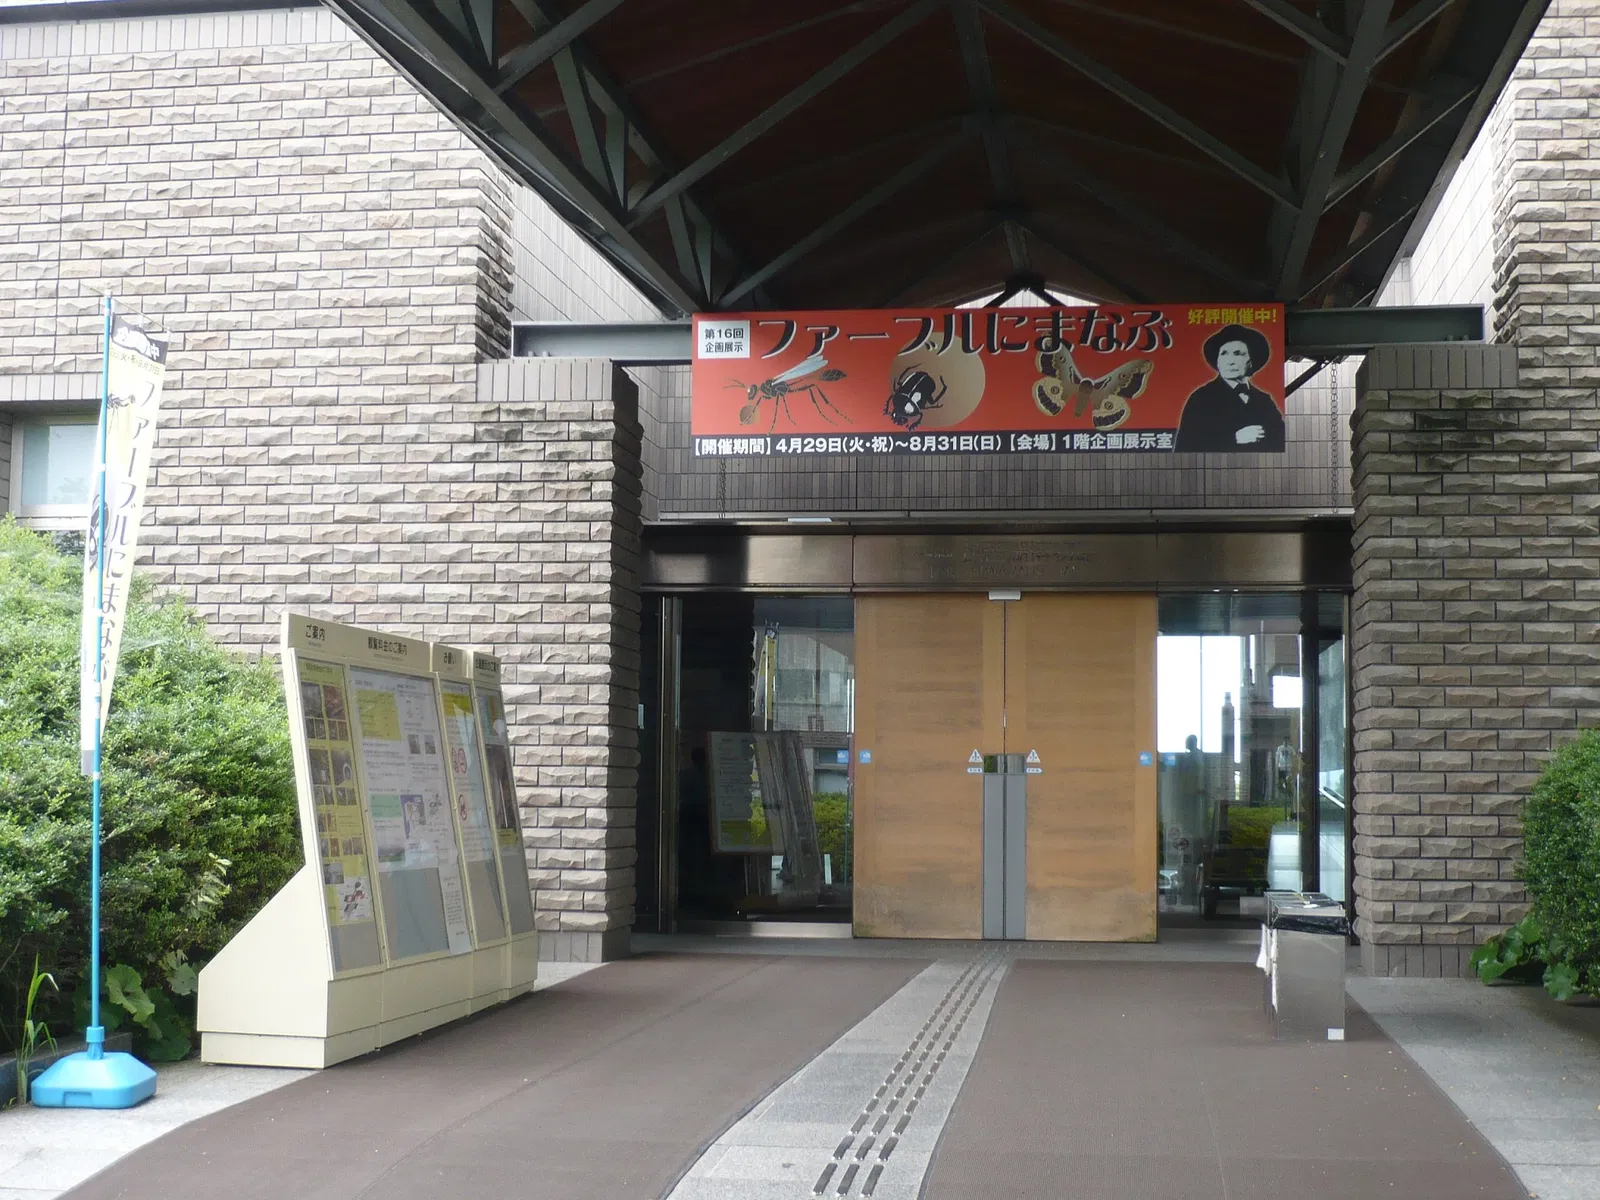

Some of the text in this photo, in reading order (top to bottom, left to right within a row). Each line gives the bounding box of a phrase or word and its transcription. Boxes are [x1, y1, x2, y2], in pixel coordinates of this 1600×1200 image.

[1188, 308, 1277, 324] 好評開催中!
[704, 328, 744, 340] 第16回
[756, 309, 1174, 359] ファーブルにまなぶ
[705, 341, 743, 353] 企画展示
[305, 624, 325, 642] ご案内
